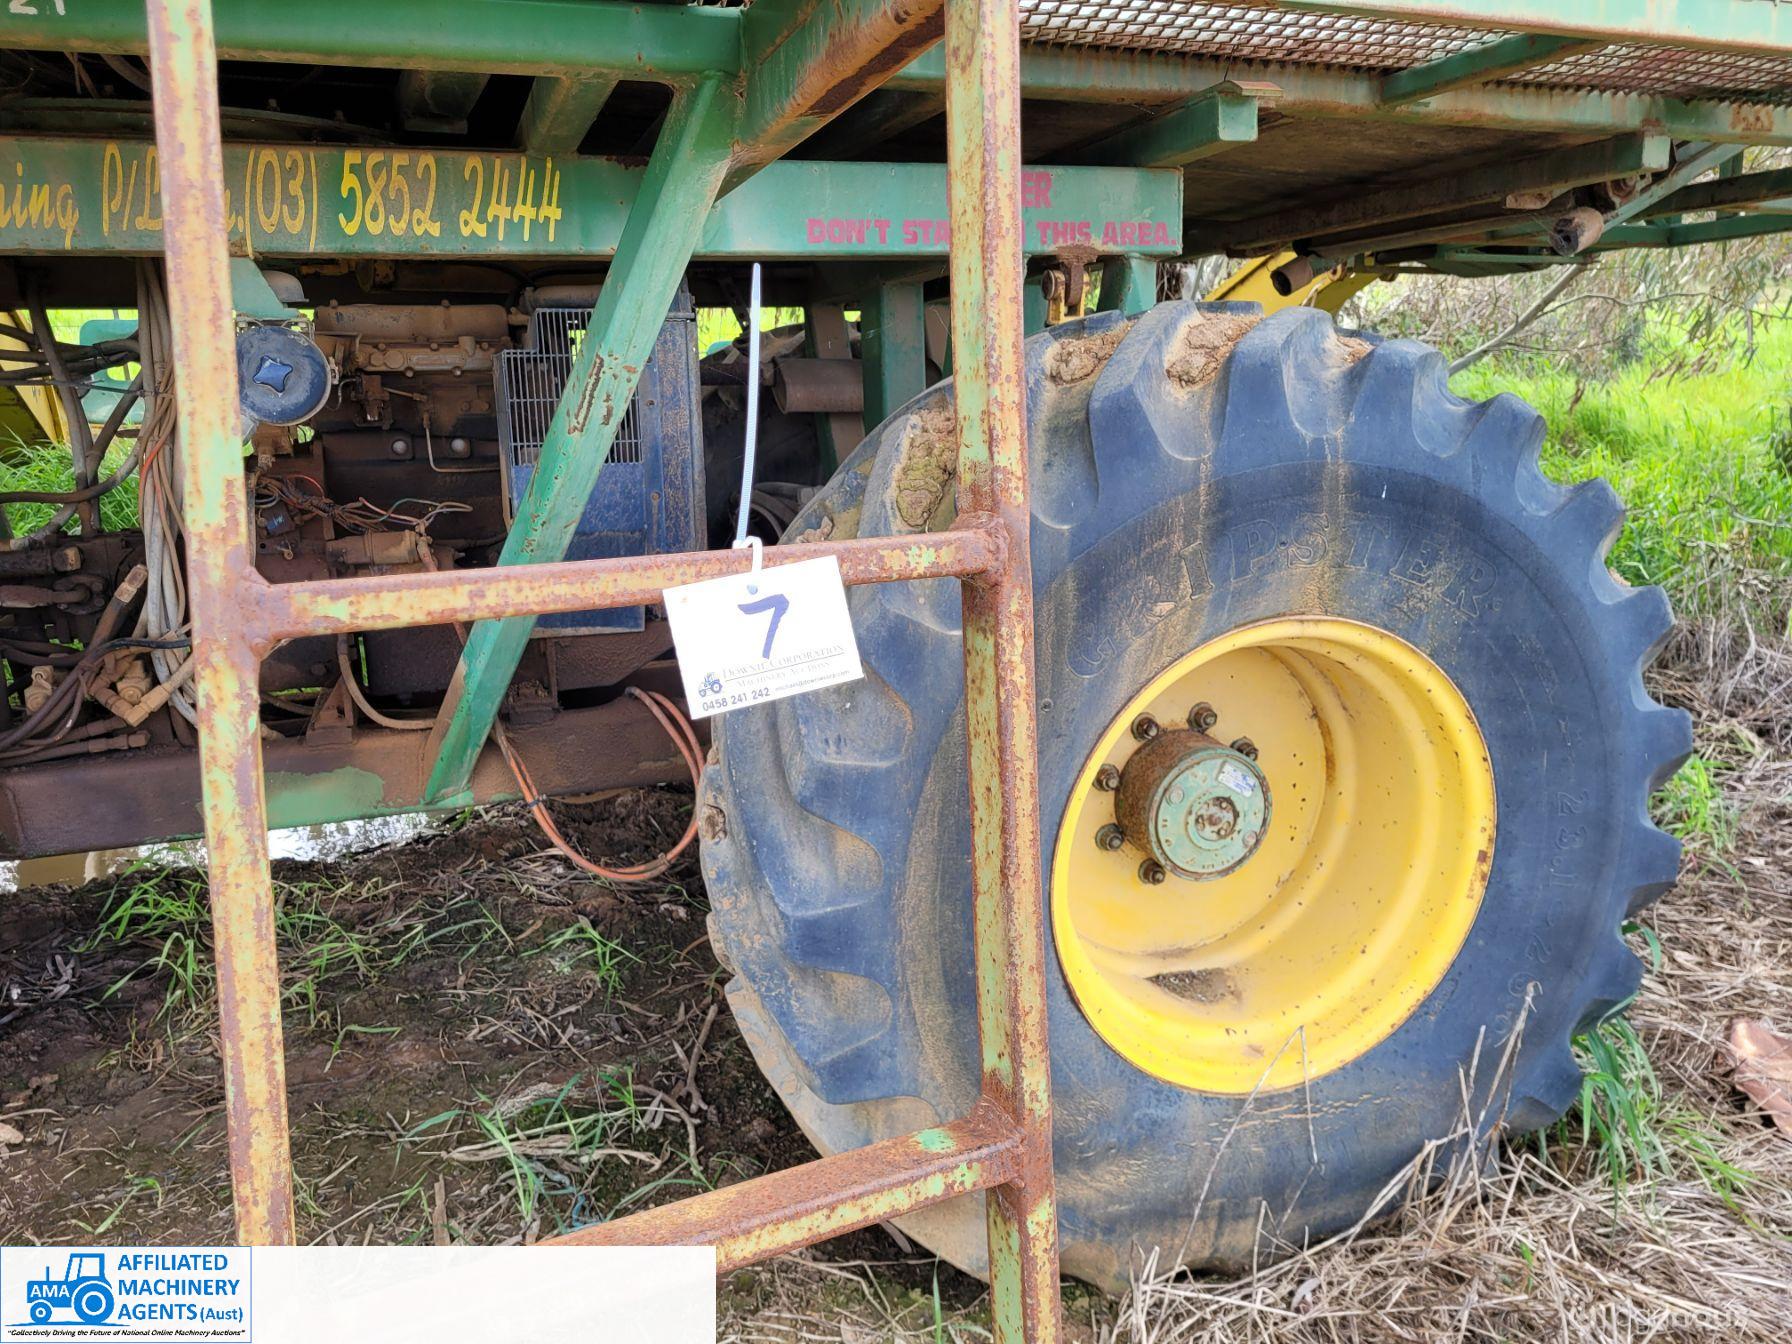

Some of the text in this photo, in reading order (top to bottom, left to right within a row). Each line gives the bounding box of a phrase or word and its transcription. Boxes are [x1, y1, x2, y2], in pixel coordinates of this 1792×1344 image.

[338, 150, 440, 237] 5852
[459, 155, 562, 242] 2444
[806, 217, 890, 245] DON'T
[1037, 221, 1091, 246] THIS
[1102, 221, 1178, 247] AREA.
[737, 593, 790, 660] 7
[702, 697, 728, 712] 0458
[731, 692, 748, 706] 241
[751, 687, 771, 701] 242
